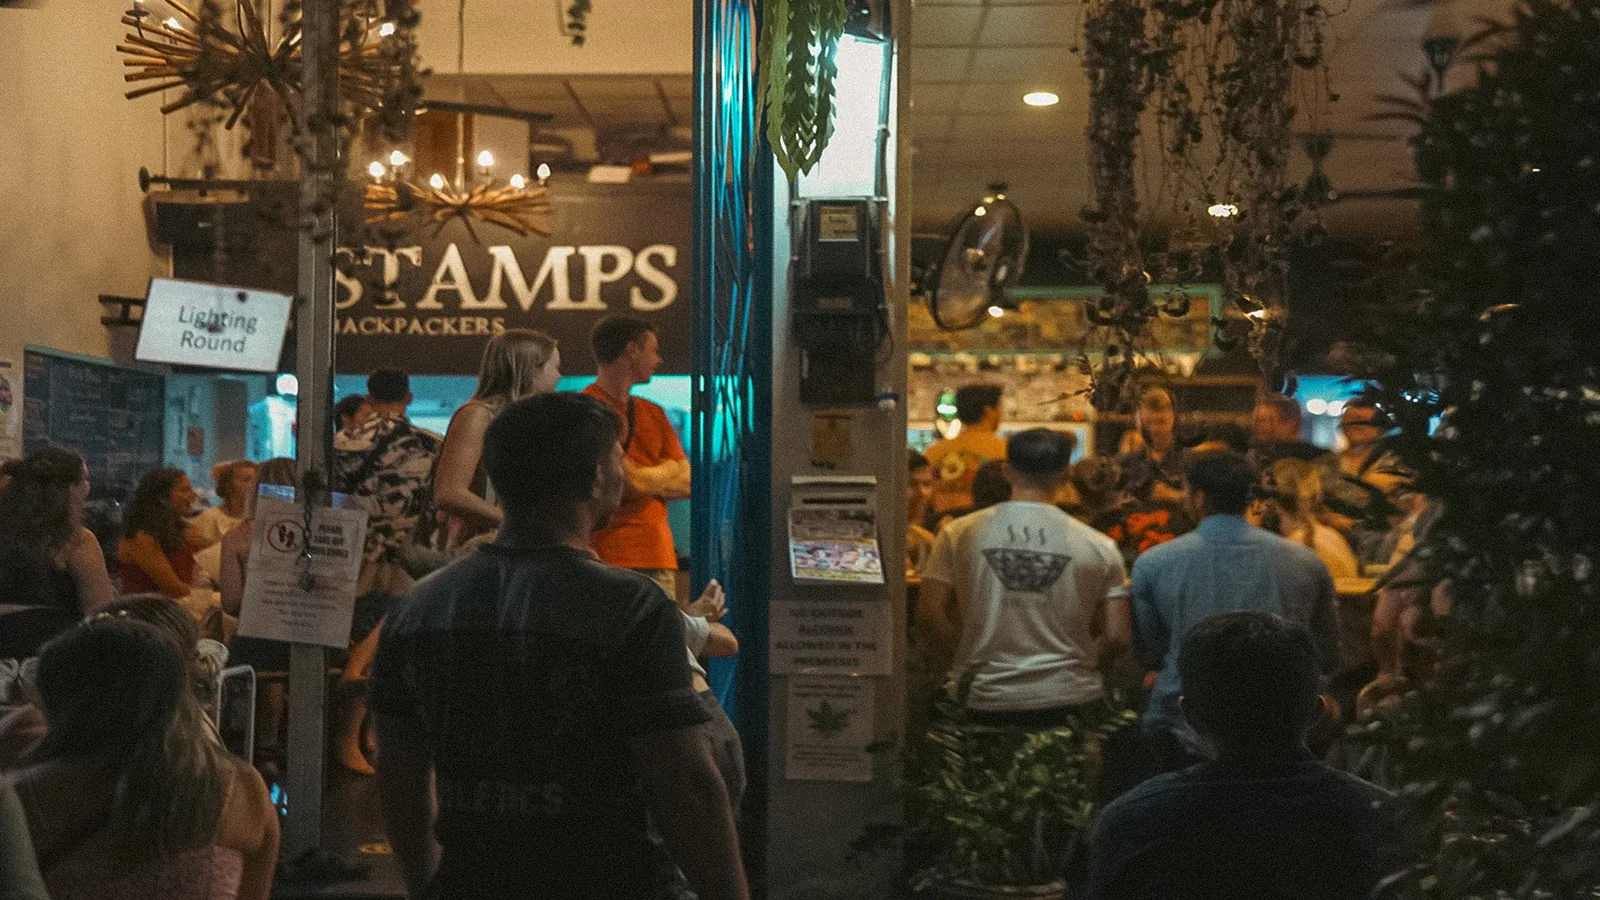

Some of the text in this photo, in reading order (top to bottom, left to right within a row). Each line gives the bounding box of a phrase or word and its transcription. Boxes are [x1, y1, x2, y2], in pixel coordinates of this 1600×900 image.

[335, 243, 677, 311] STAMPS
[178, 305, 258, 334] Lighting
[335, 316, 505, 336] ACKPACKERS
[180, 330, 247, 353] Round
